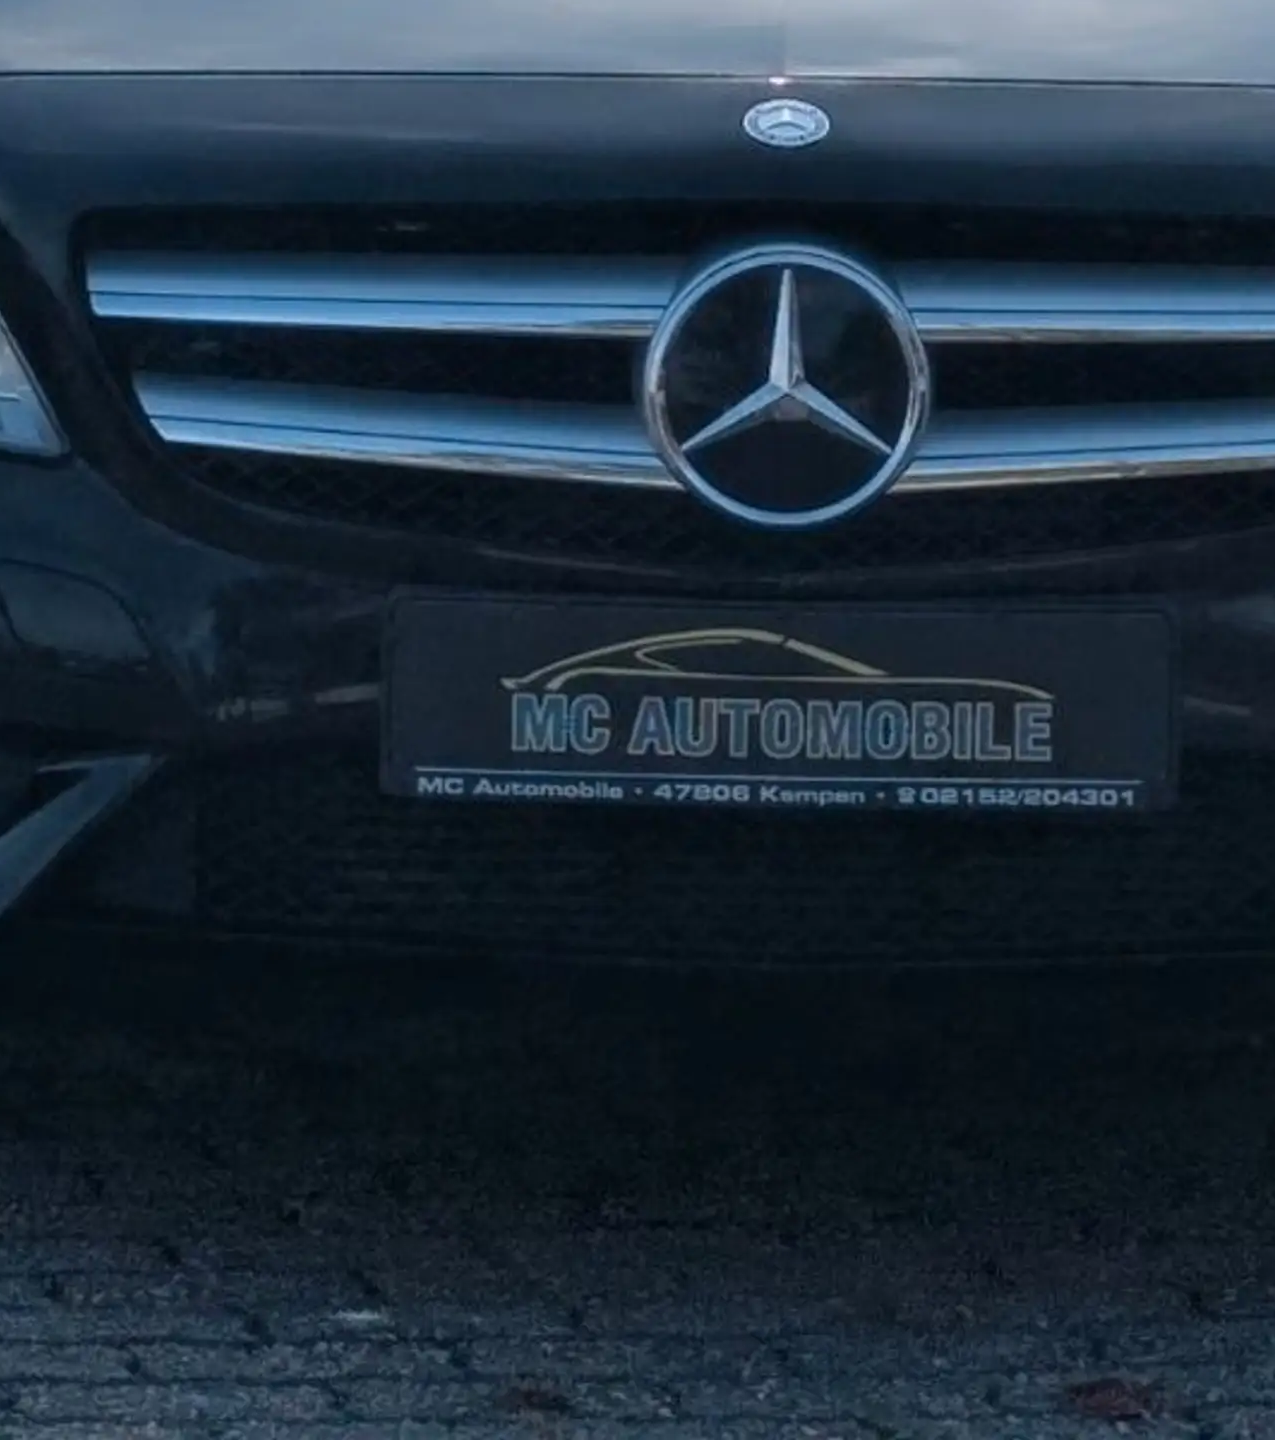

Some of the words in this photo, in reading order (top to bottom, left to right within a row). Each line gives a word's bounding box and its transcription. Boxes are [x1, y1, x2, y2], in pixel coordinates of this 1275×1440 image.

[511, 692, 612, 754] MC
[627, 697, 1053, 761] AUTOMOBILE
[417, 776, 464, 795] MC
[475, 778, 624, 800] Automobile
[759, 784, 866, 807] Kempen
